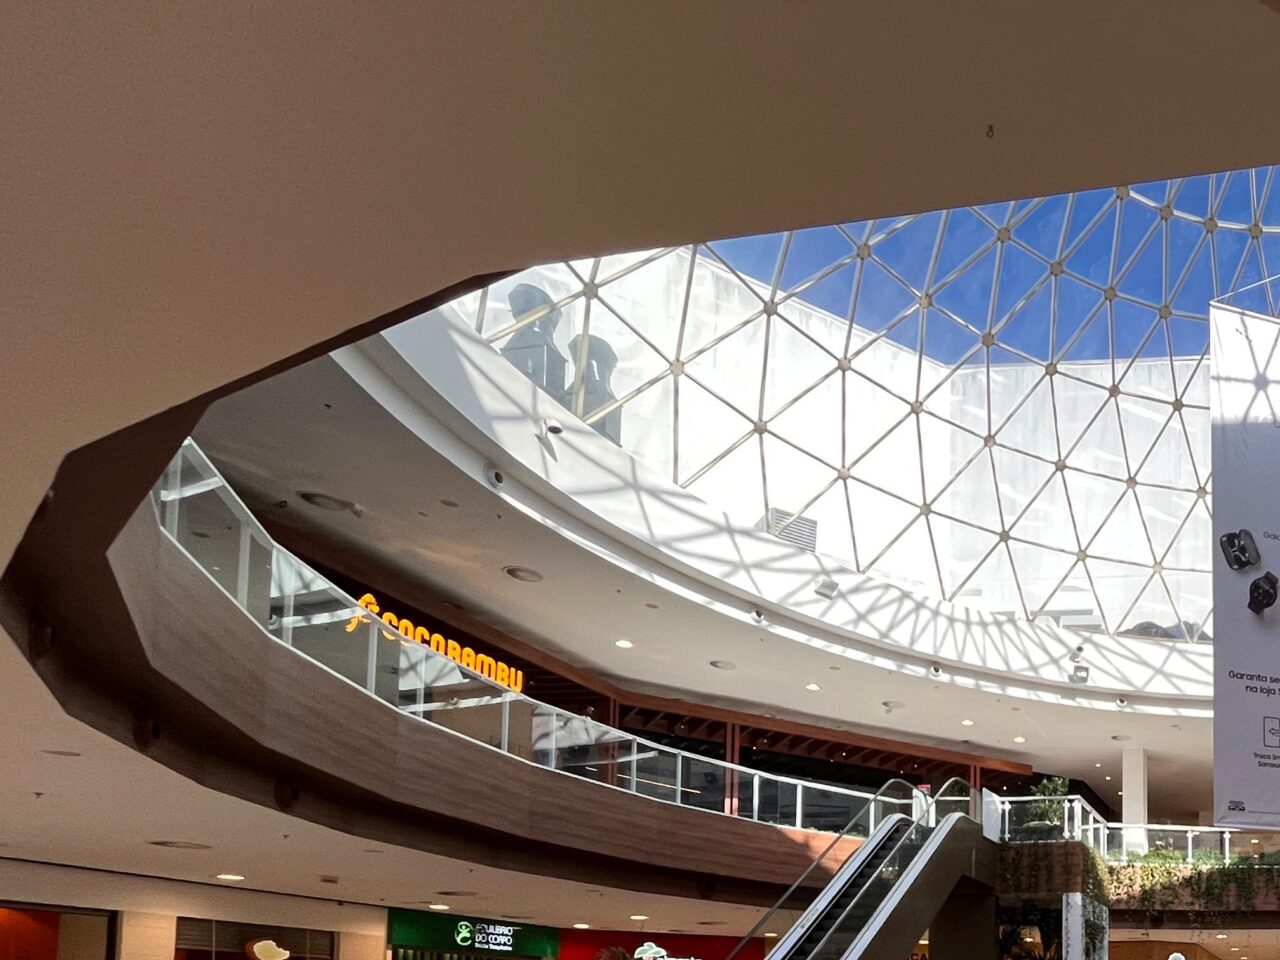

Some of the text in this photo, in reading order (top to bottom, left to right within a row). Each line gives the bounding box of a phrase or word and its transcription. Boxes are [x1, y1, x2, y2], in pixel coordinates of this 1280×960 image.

[1228, 670, 1267, 683] Garanta
[1245, 684, 1258, 693] na
[1260, 685, 1276, 697] loja
